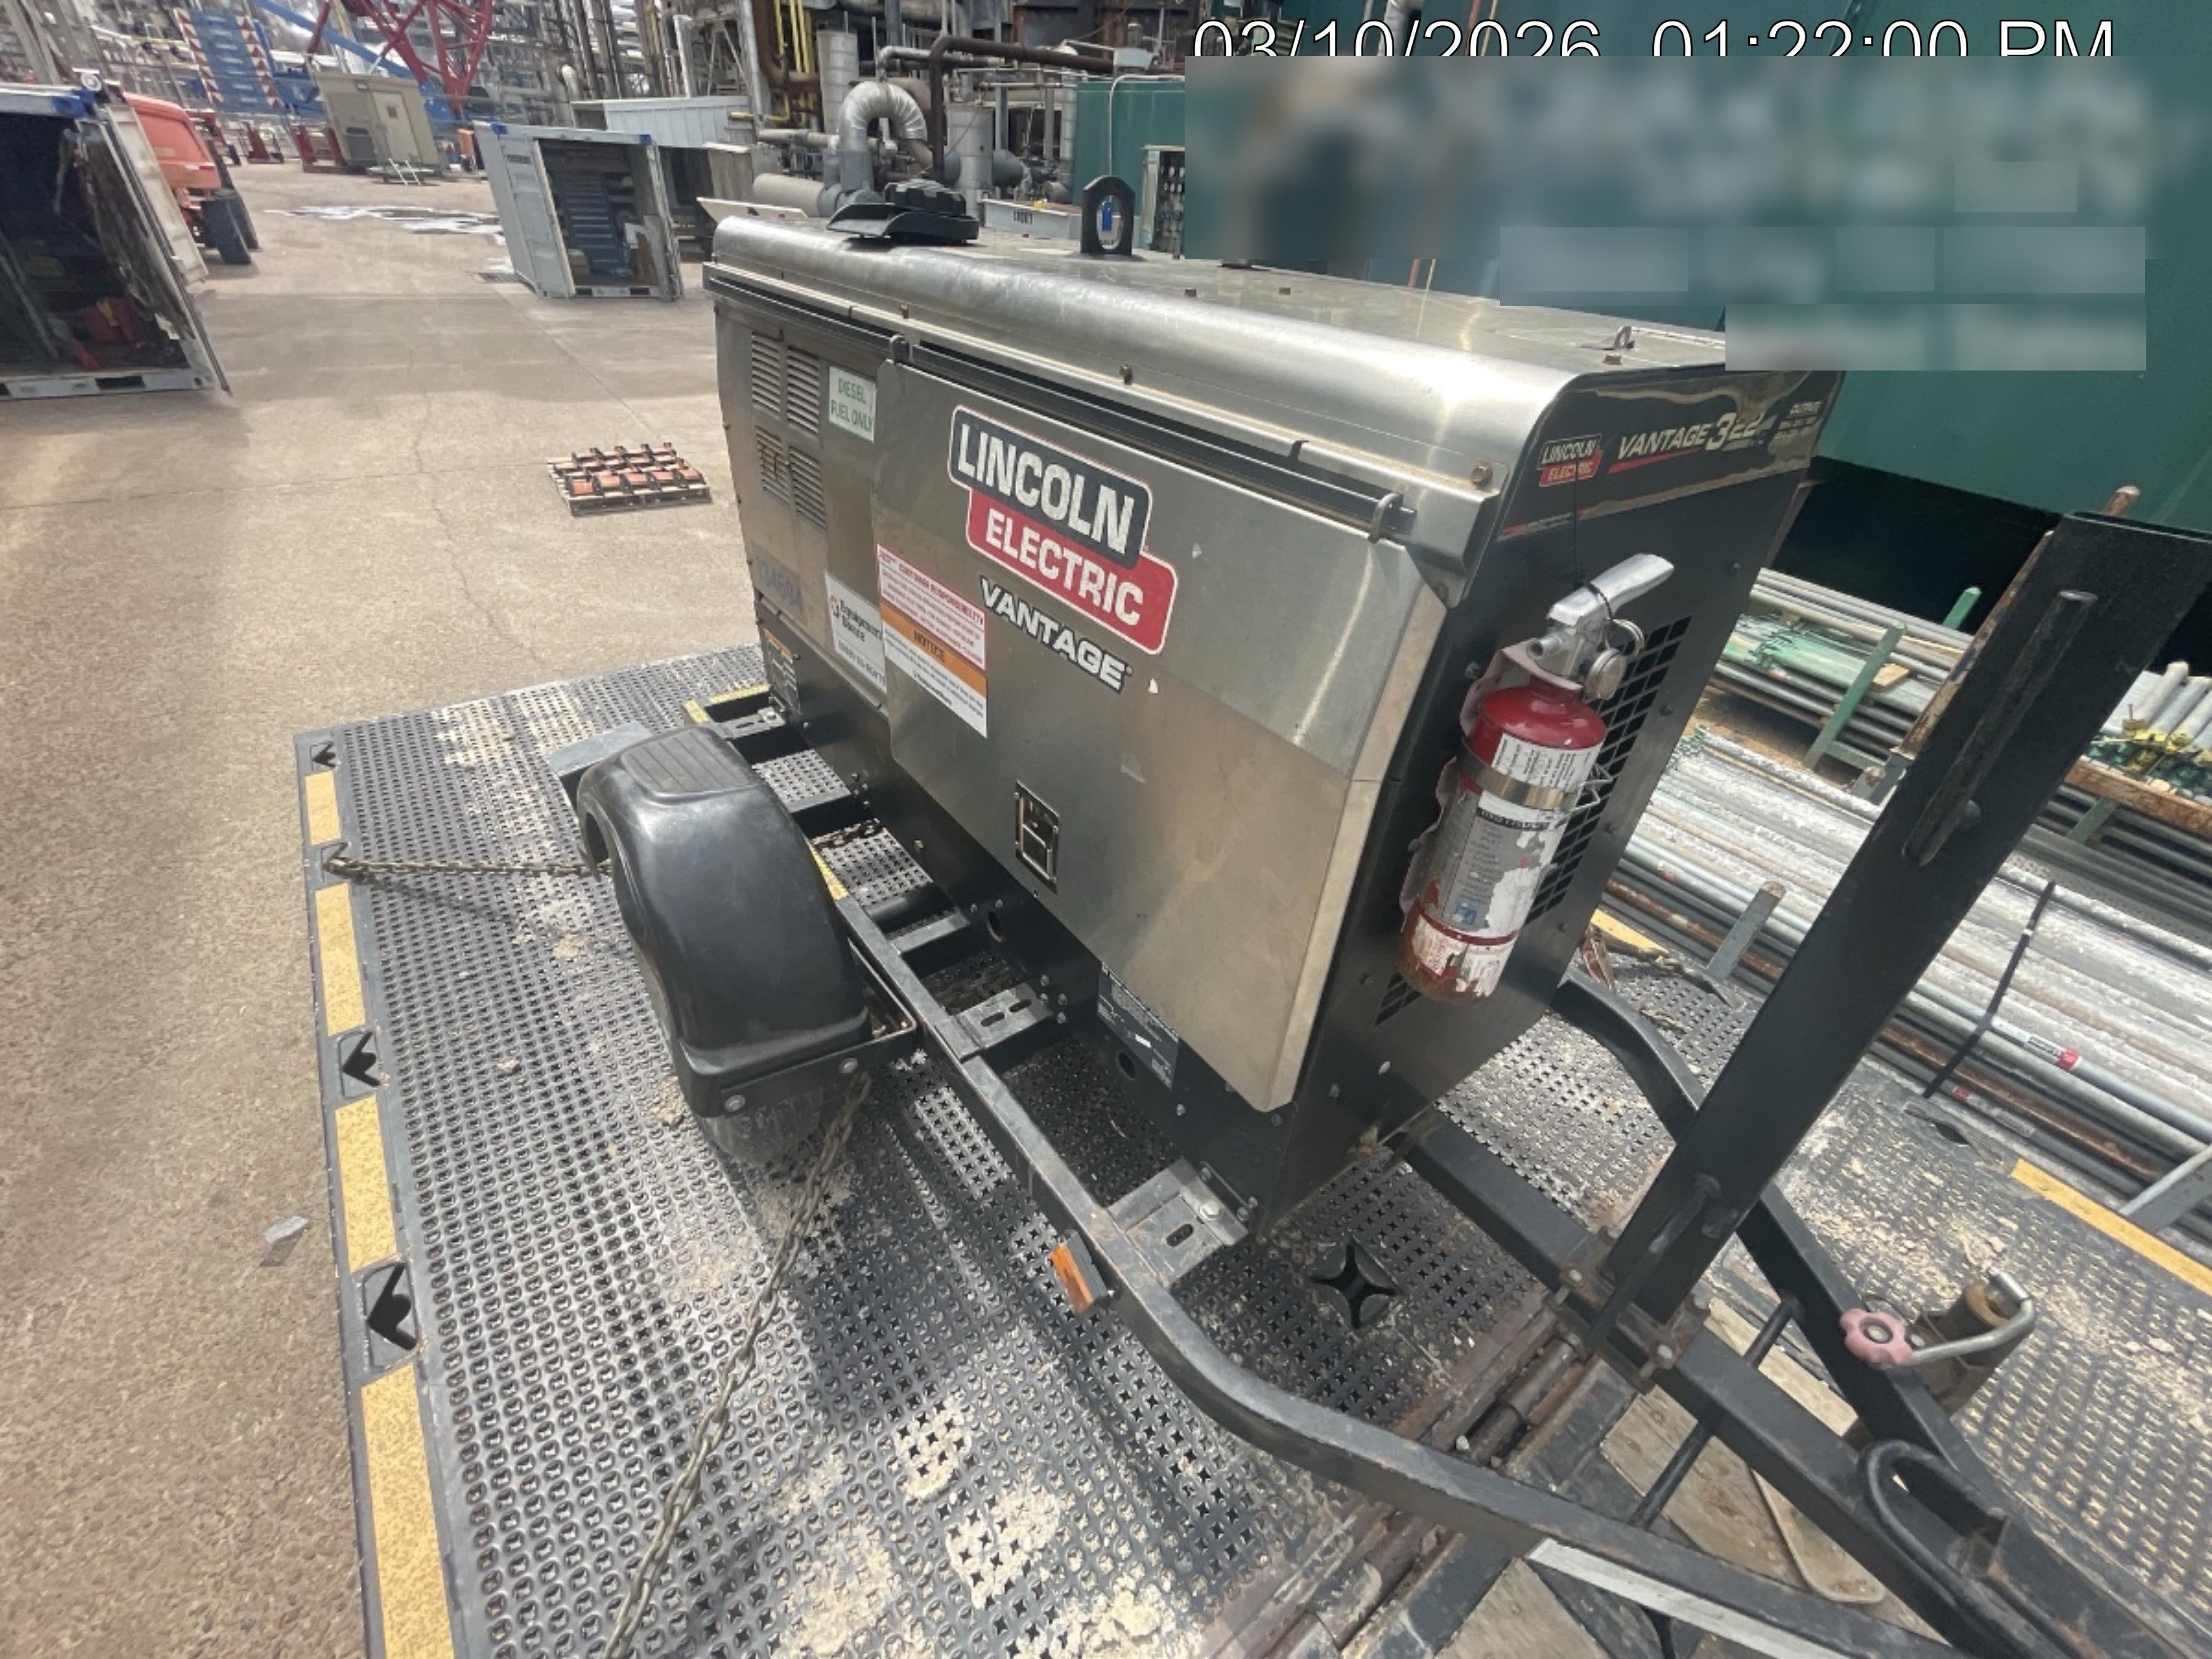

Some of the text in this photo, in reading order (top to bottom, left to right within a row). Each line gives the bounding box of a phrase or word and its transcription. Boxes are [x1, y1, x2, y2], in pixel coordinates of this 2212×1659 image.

[958, 424, 1135, 555] LINCOLN
[1540, 439, 1599, 465] LINCOLN
[1618, 423, 1713, 460] VANTAGE
[986, 508, 1144, 626] ELECTRIC
[981, 578, 1126, 691] VANTAGE
